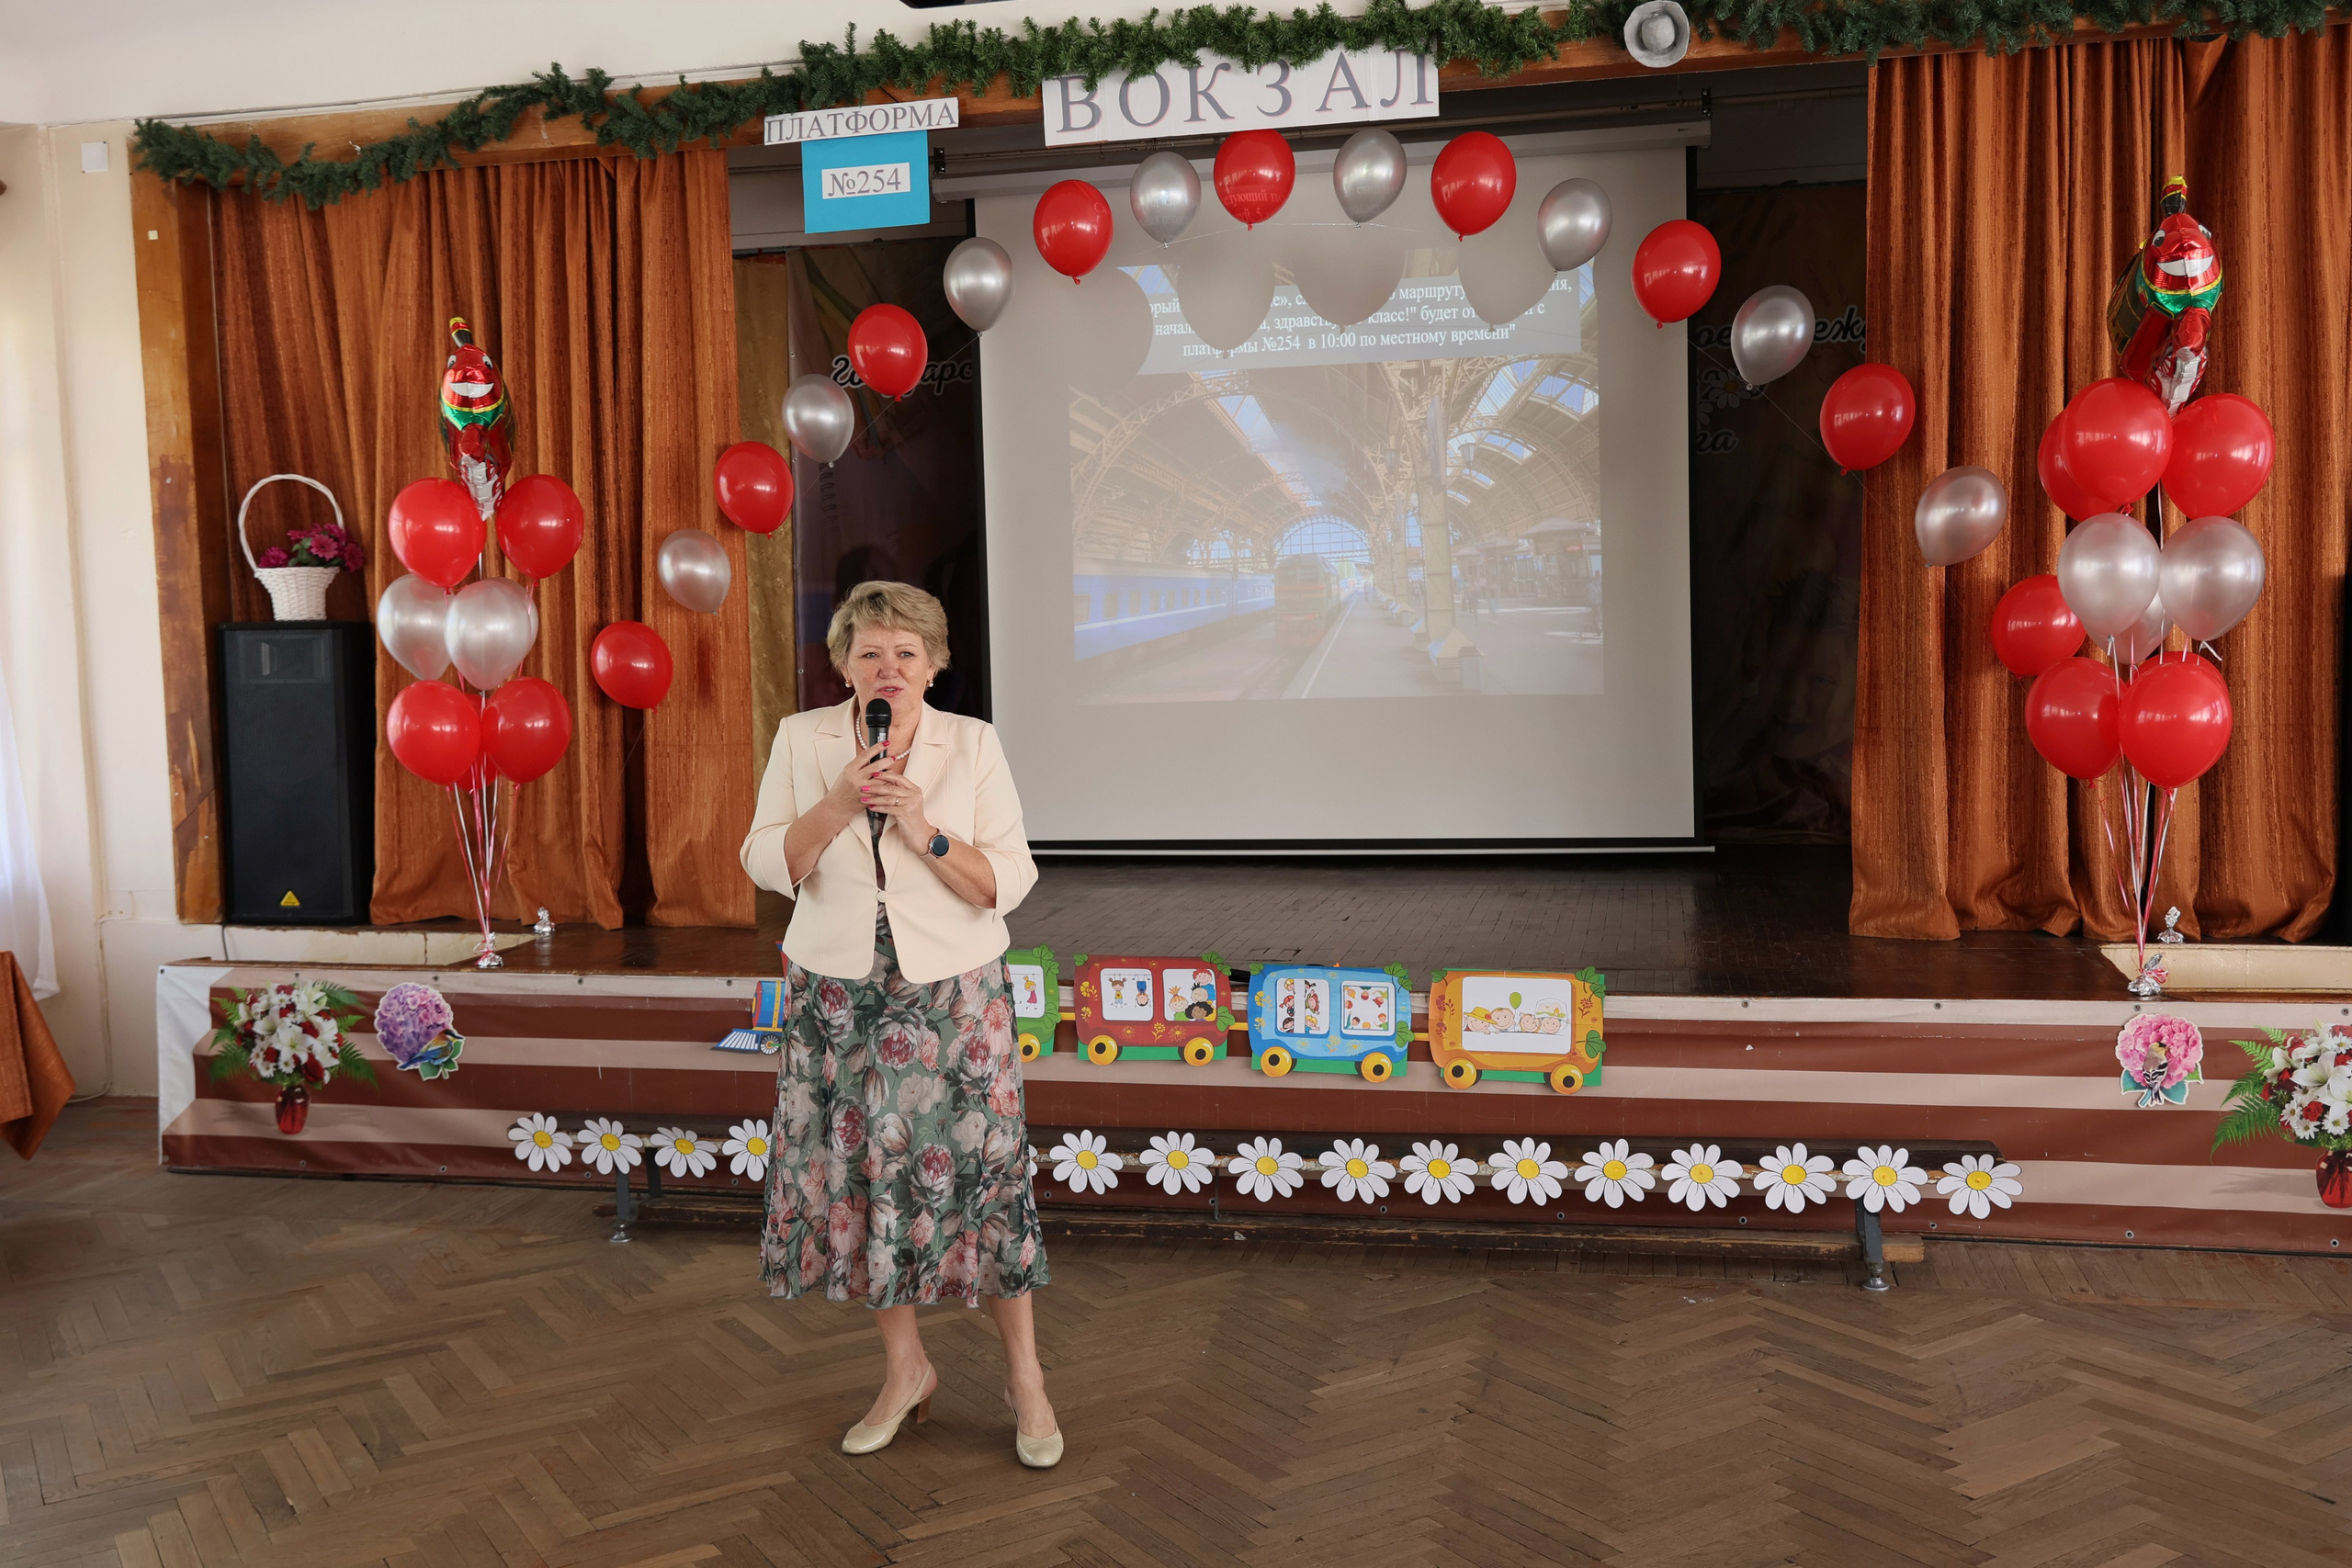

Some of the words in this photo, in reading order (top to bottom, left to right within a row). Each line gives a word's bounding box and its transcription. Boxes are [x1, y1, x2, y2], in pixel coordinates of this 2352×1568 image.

[1057, 49, 1434, 134] ВОКЗАЛ
[766, 102, 956, 143] ПЛАТФОРМА
[828, 167, 901, 197] №254
[1155, 322, 1194, 336] начал
[1420, 305, 1459, 324] будет
[1183, 341, 1258, 358] платфрмы
[1261, 334, 1301, 352] №254
[1308, 338, 1317, 350] в
[1320, 332, 1356, 349] 10:00
[1360, 334, 1376, 347] по
[1380, 331, 1447, 346] местному
